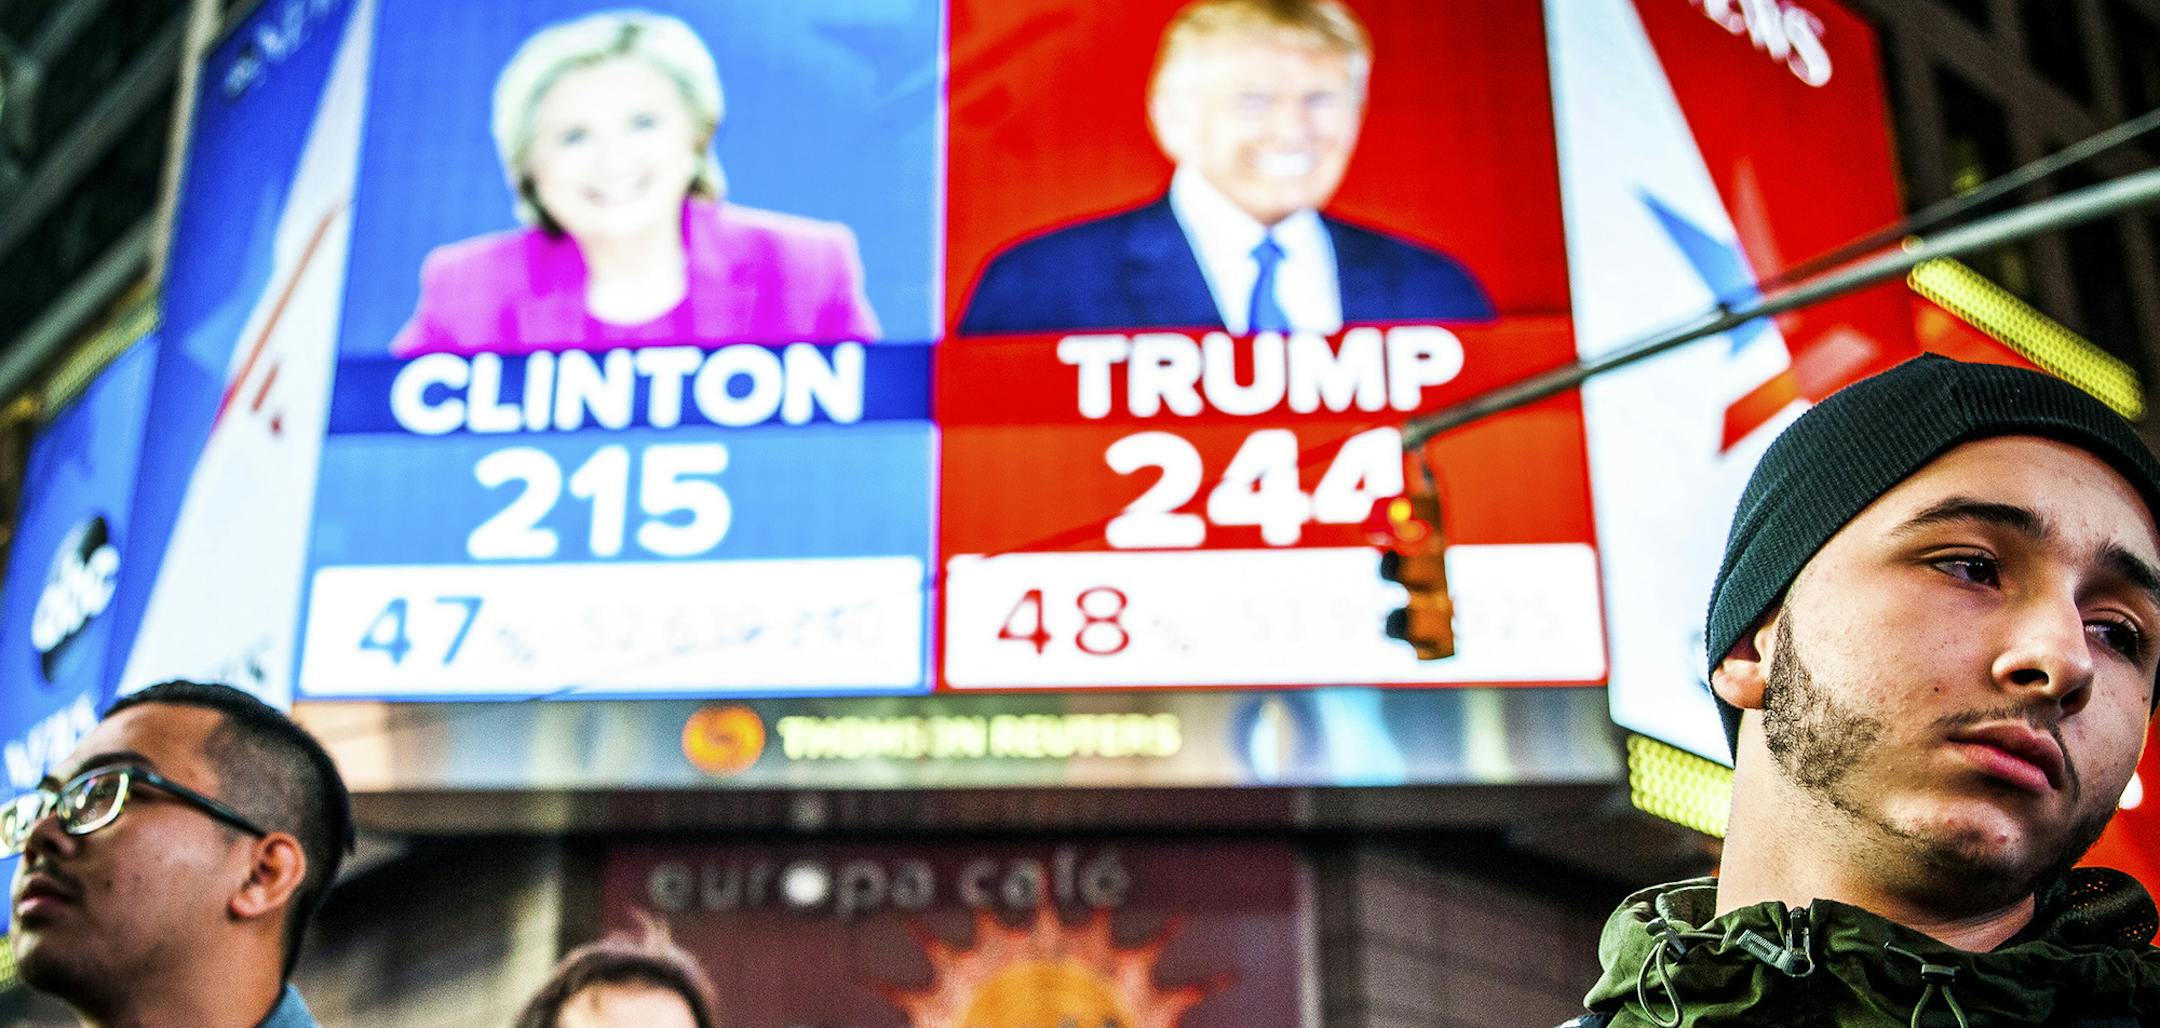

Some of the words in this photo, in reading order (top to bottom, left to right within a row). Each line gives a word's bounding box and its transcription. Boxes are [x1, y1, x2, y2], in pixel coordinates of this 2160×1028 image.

[1688, 0, 1833, 88] EWS
[390, 341, 866, 435] CLINTON
[1057, 326, 1465, 419] TRUMP
[467, 442, 733, 559] 215
[1104, 426, 1405, 549] 244
[31, 544, 121, 652] abc
[989, 713, 1183, 758] REUTERS
[646, 858, 936, 924] europa
